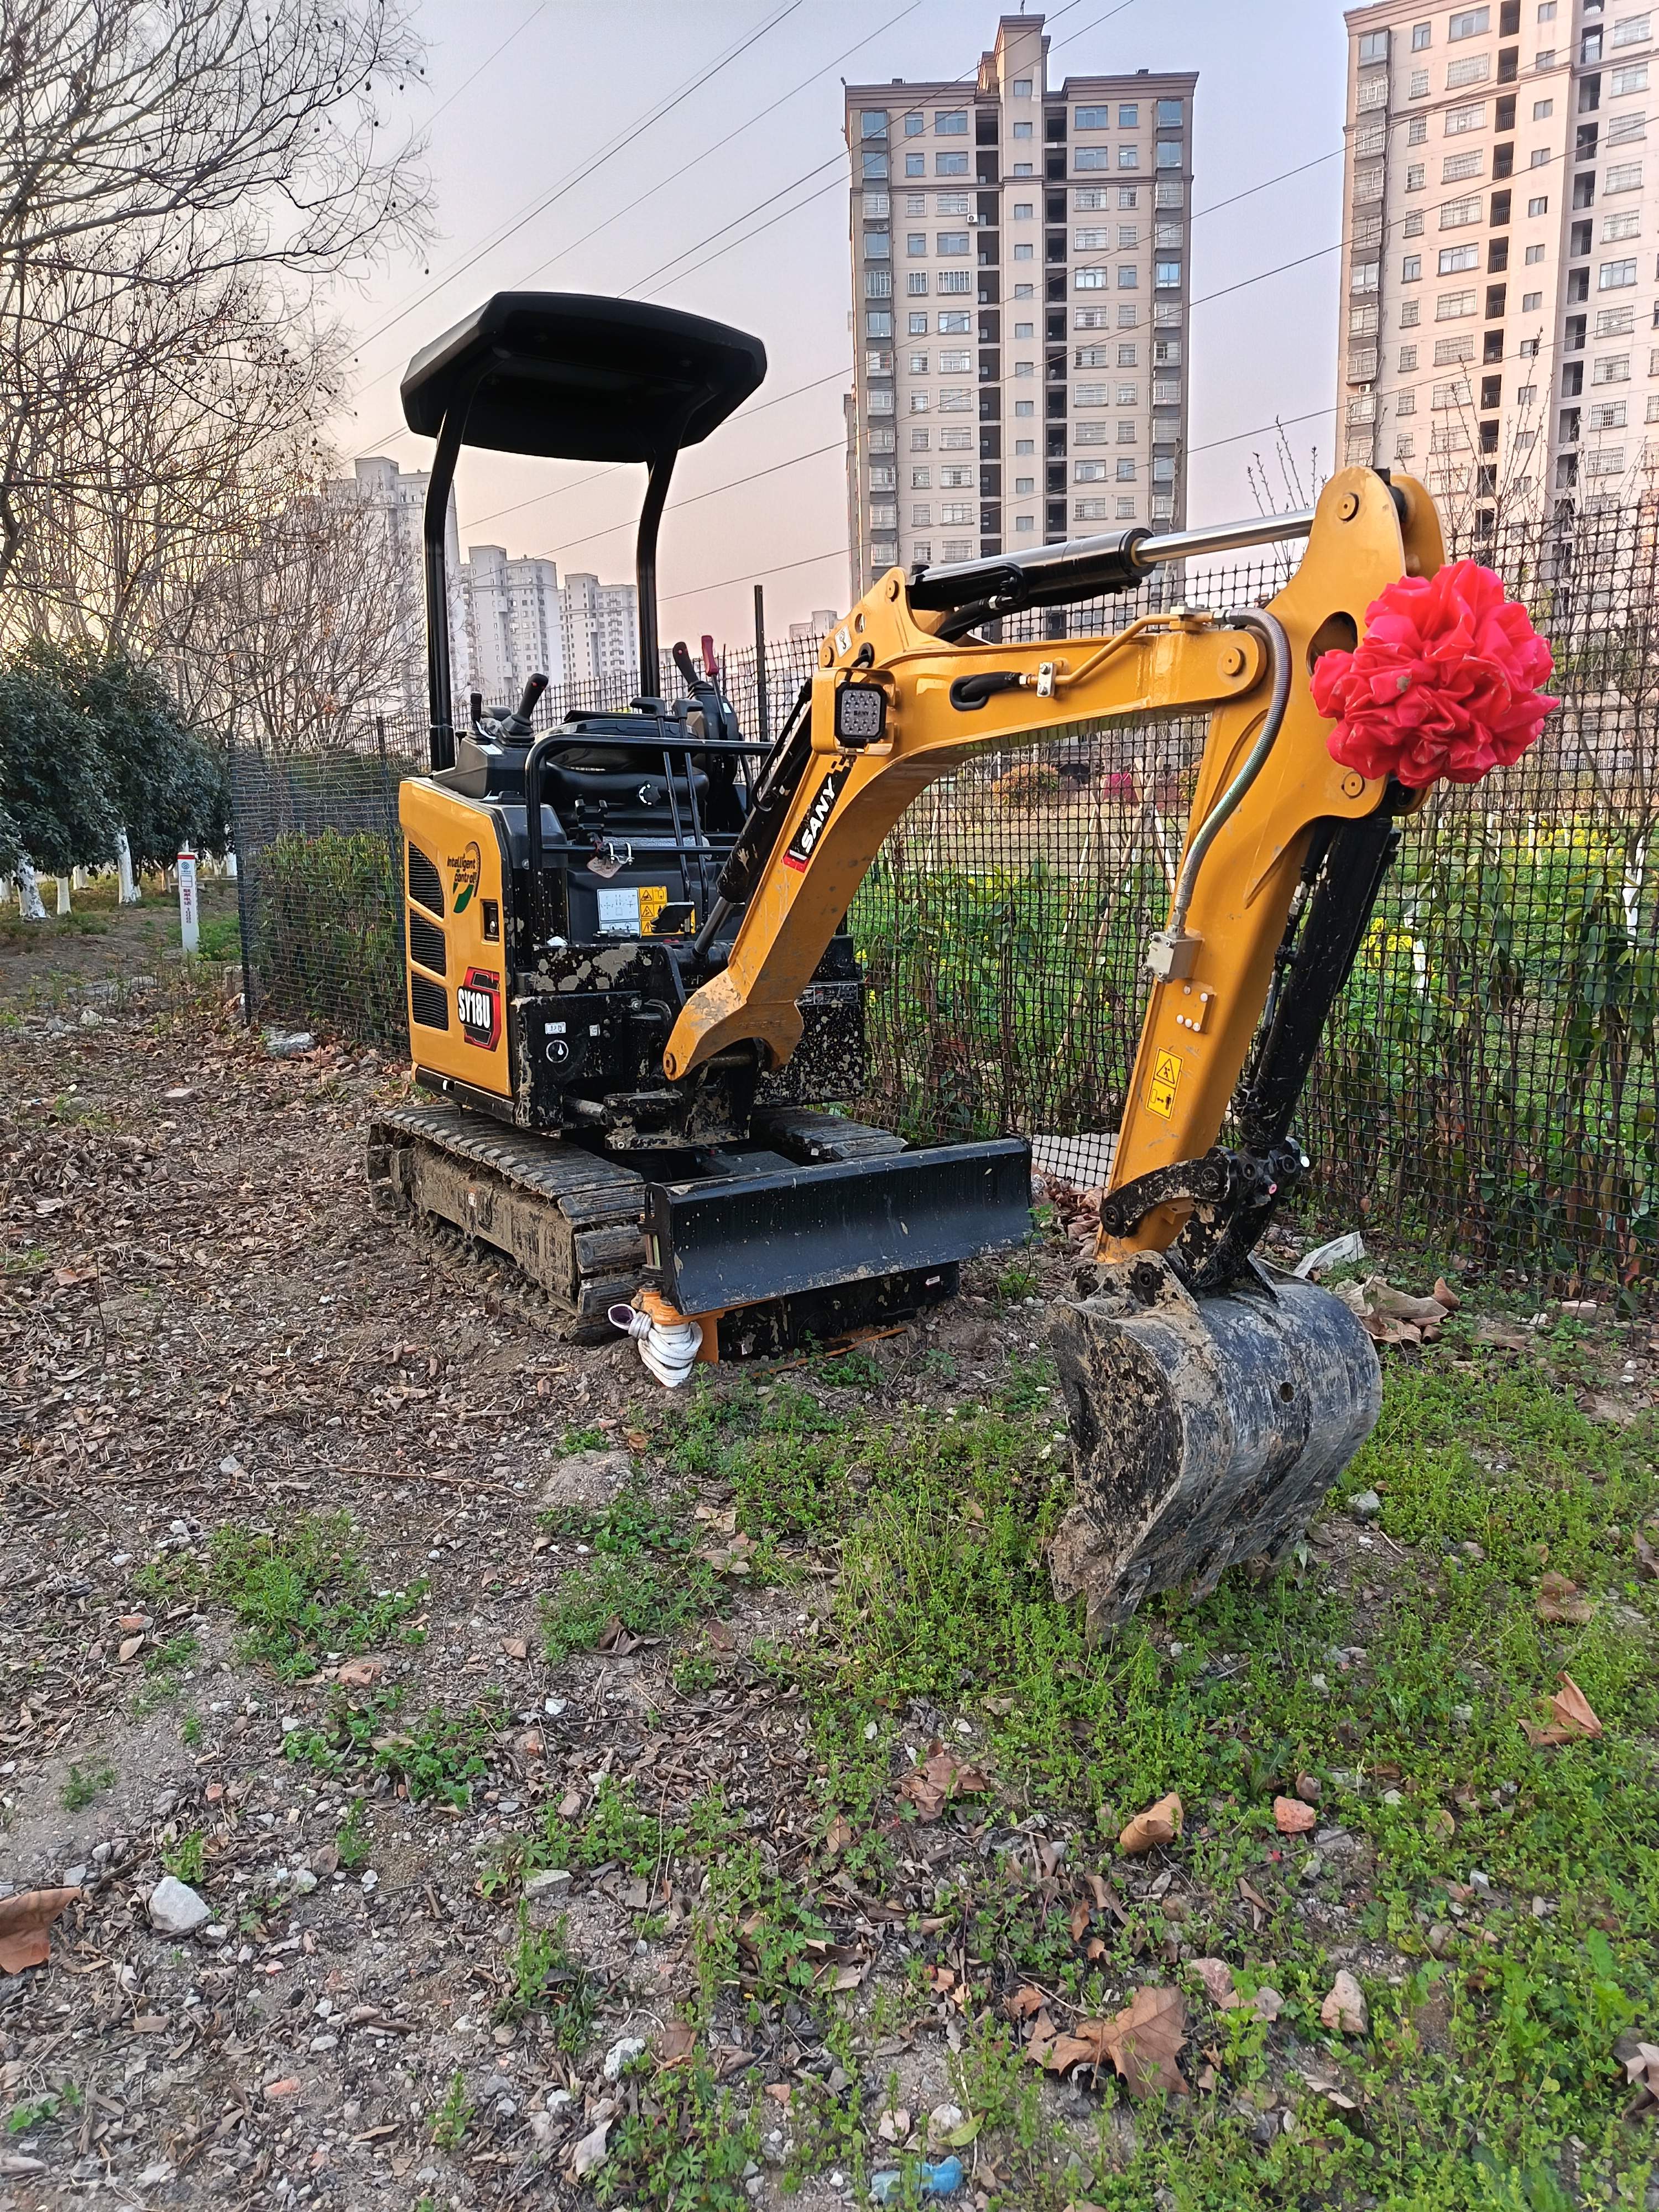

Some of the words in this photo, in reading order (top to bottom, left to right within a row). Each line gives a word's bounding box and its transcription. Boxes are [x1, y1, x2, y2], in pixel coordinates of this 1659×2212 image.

[802, 776, 834, 853] SANY
[447, 853, 476, 872] Intelligent
[458, 988, 491, 1029] SY18U
